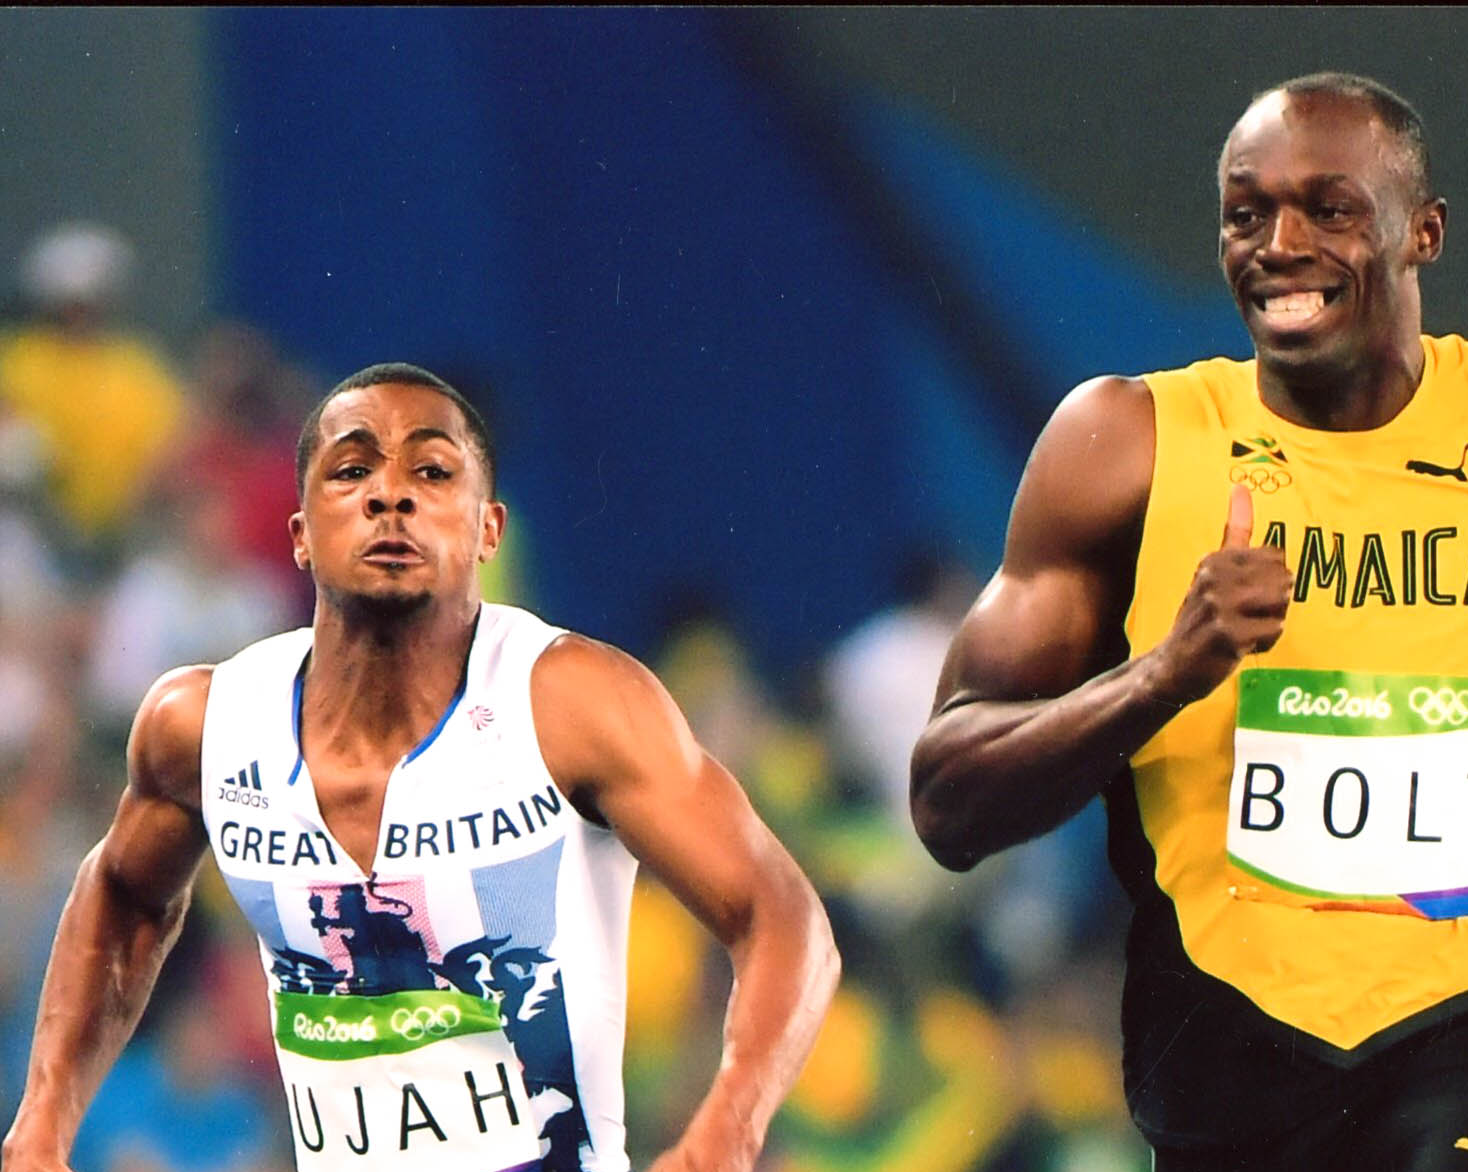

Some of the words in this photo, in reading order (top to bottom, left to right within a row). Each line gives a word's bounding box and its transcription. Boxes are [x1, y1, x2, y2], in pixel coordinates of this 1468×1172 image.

[1278, 686, 1391, 719] Rio2016
[384, 785, 561, 858] BRITAIN
[293, 1012, 376, 1042] Rio2016
[290, 1062, 520, 1156] UJAH
